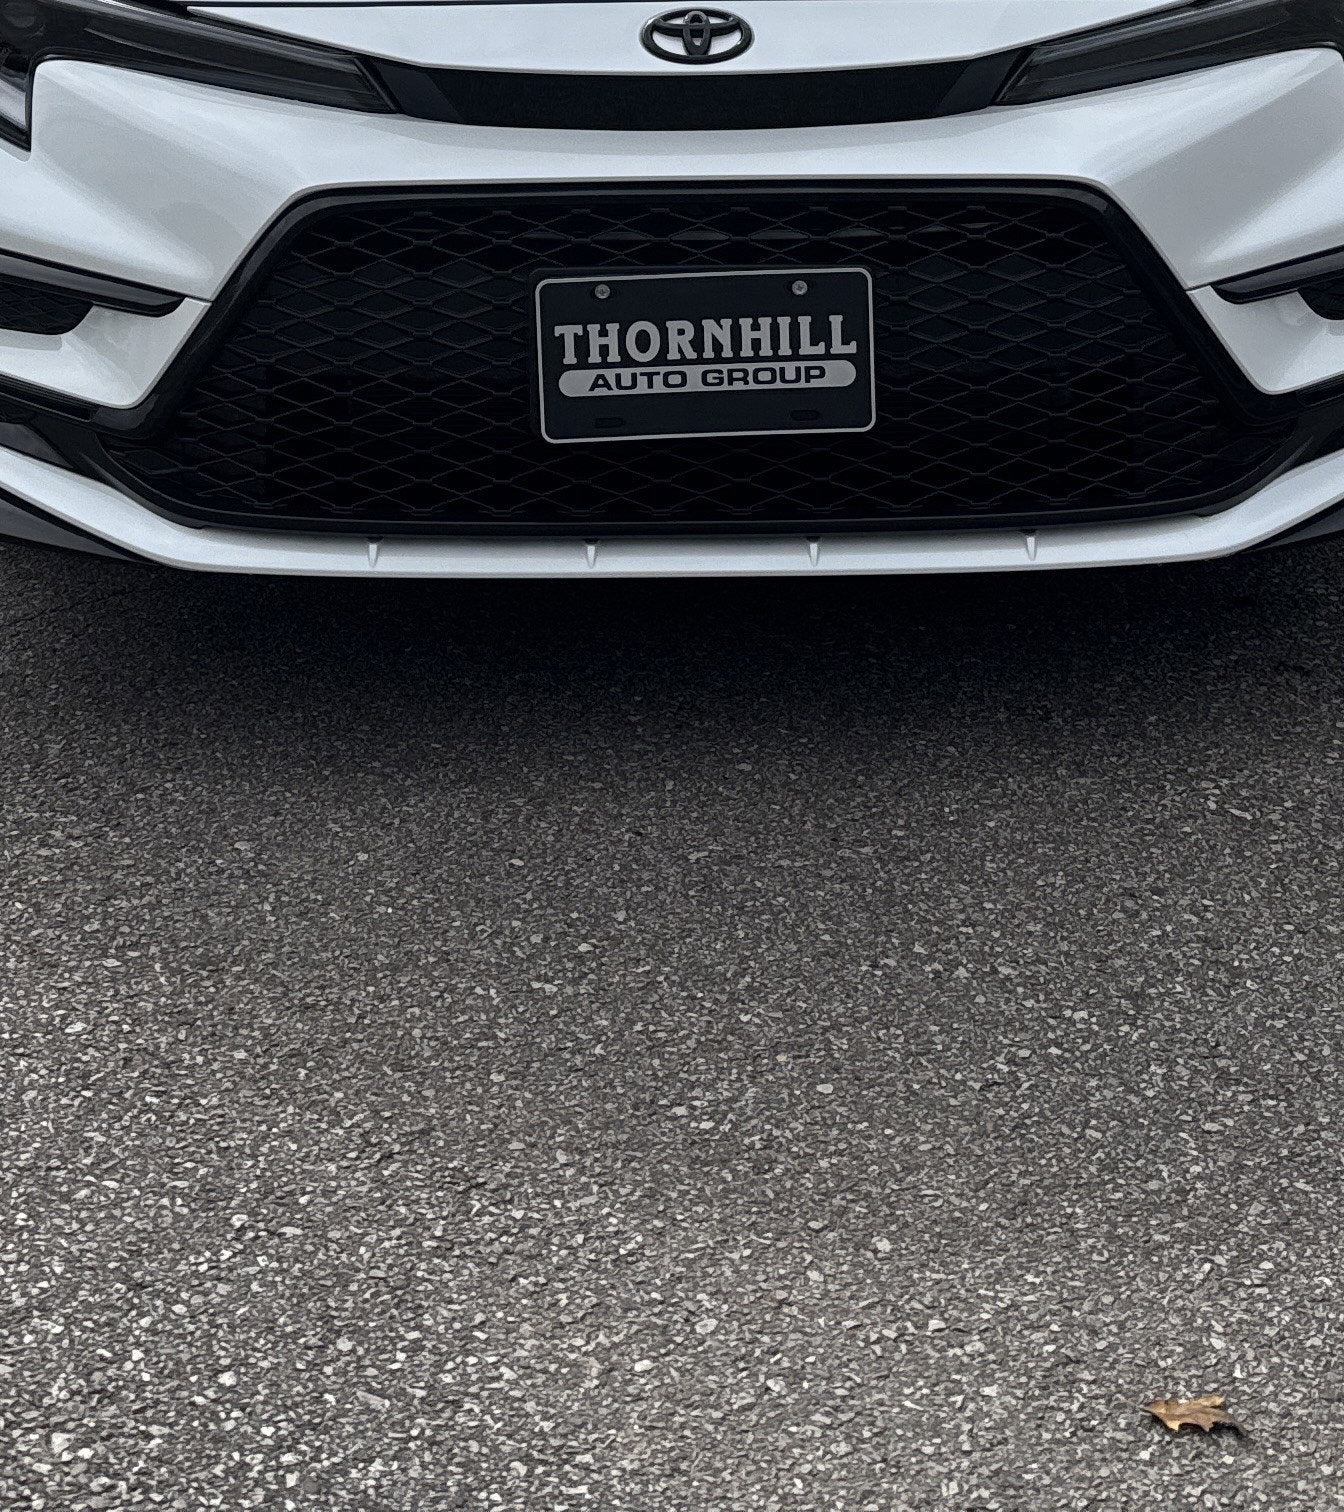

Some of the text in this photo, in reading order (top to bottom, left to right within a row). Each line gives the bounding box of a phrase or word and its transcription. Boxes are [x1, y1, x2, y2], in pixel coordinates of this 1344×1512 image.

[554, 315, 857, 364] THORNHILL
[587, 365, 827, 392] AUTO GROUP
